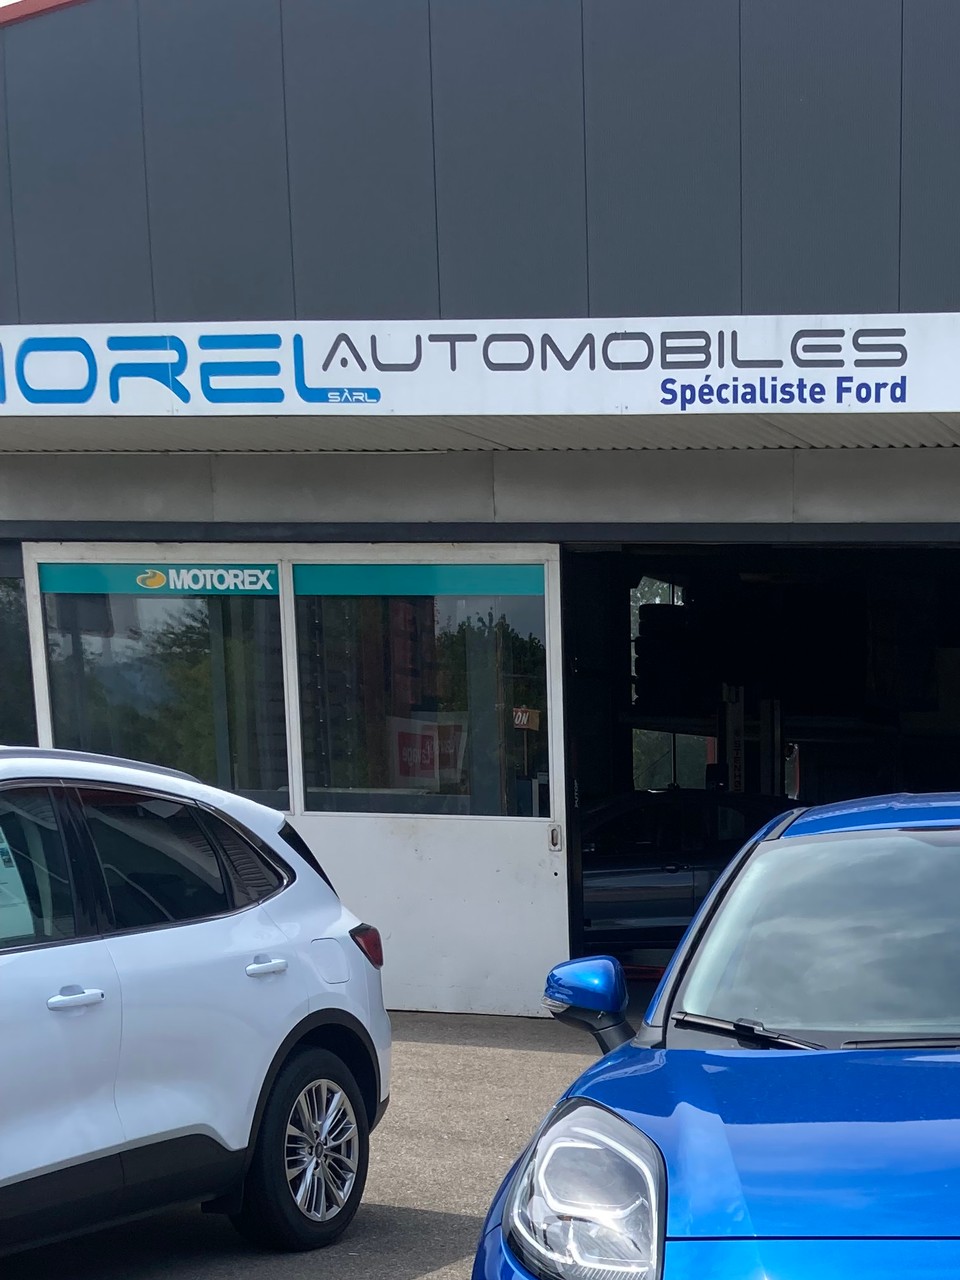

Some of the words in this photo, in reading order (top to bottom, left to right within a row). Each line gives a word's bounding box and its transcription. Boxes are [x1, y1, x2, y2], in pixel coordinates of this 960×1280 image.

[0, 333, 381, 404] OREL
[322, 328, 908, 372] AUTOMOBILES
[328, 388, 377, 402] SÀRL
[660, 375, 826, 411] Spécialiste
[836, 375, 907, 404] Ford
[168, 569, 273, 590] MOTOREX
